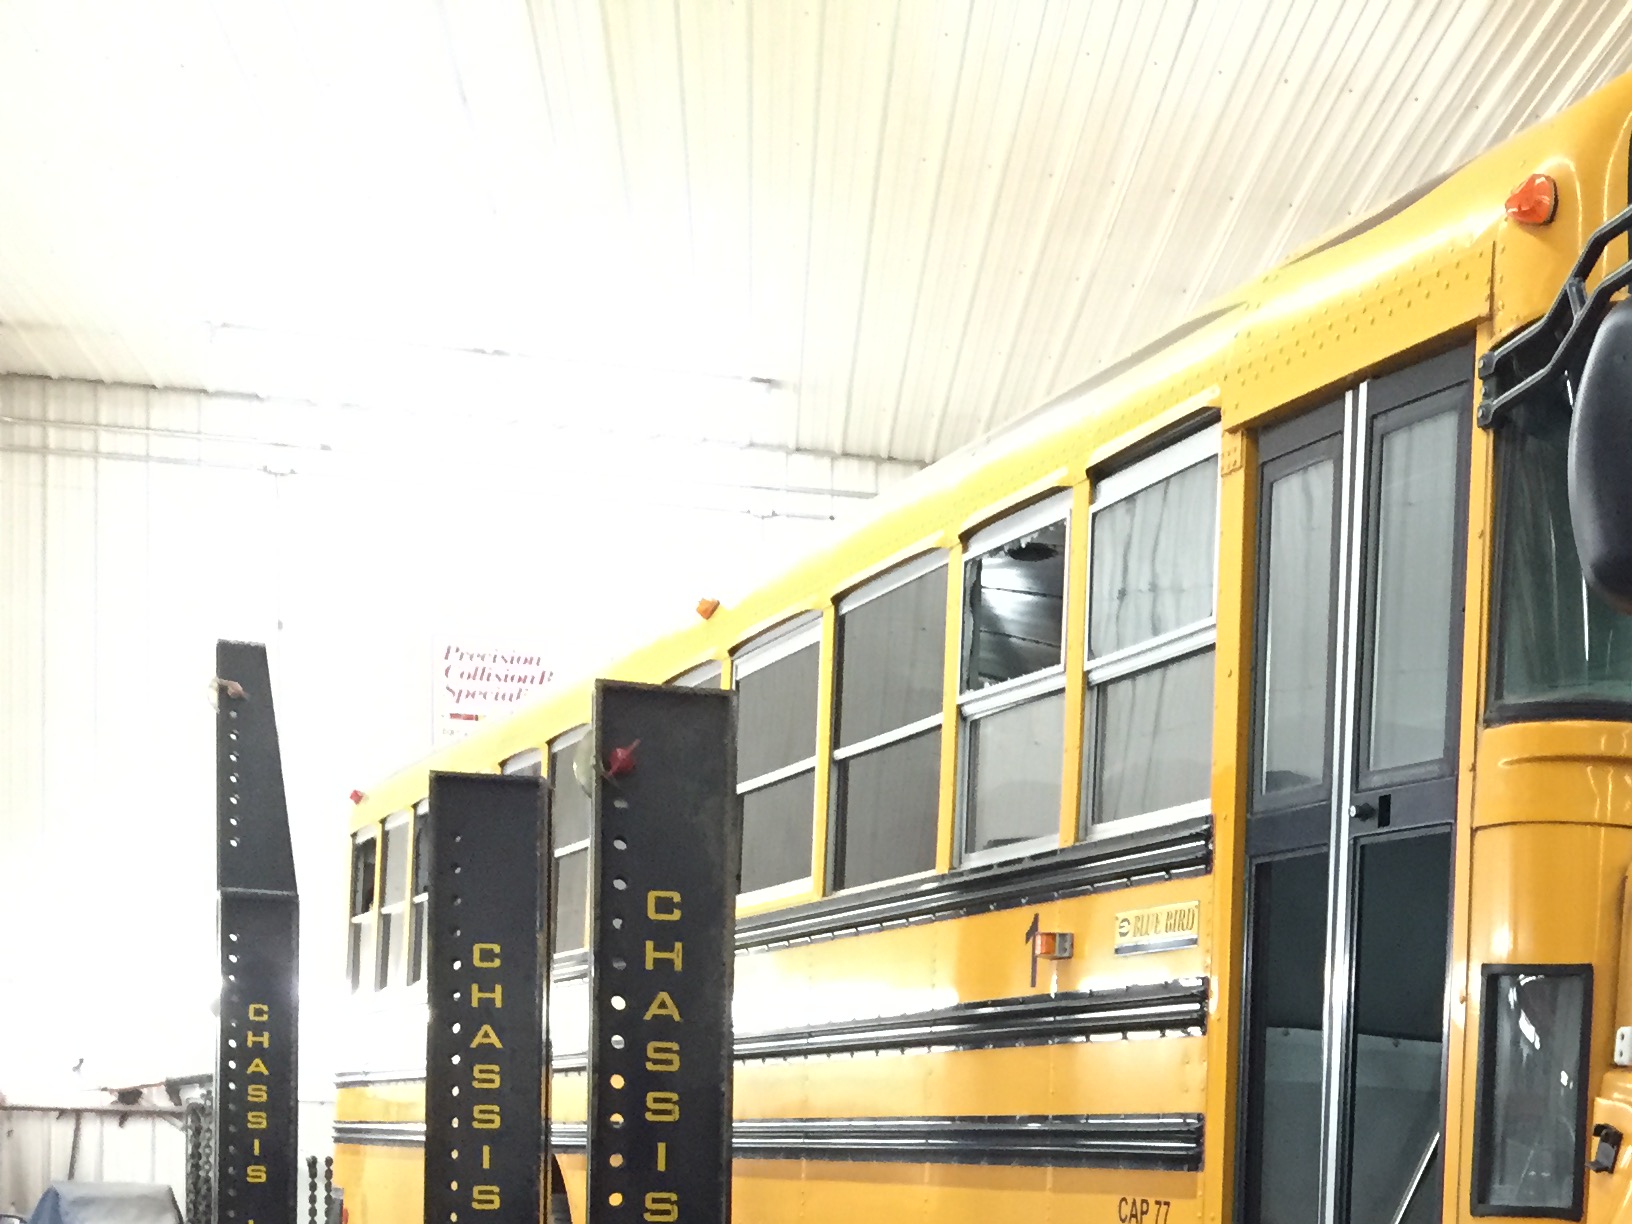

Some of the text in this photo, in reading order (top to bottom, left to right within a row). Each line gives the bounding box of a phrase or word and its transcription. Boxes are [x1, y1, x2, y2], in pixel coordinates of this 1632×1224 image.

[1133, 907, 1196, 938] BLUE BIRD
[246, 1003, 270, 1183] CHASSIS
[471, 942, 504, 1211] CHASSIS
[643, 890, 683, 1223] CHASSIS
